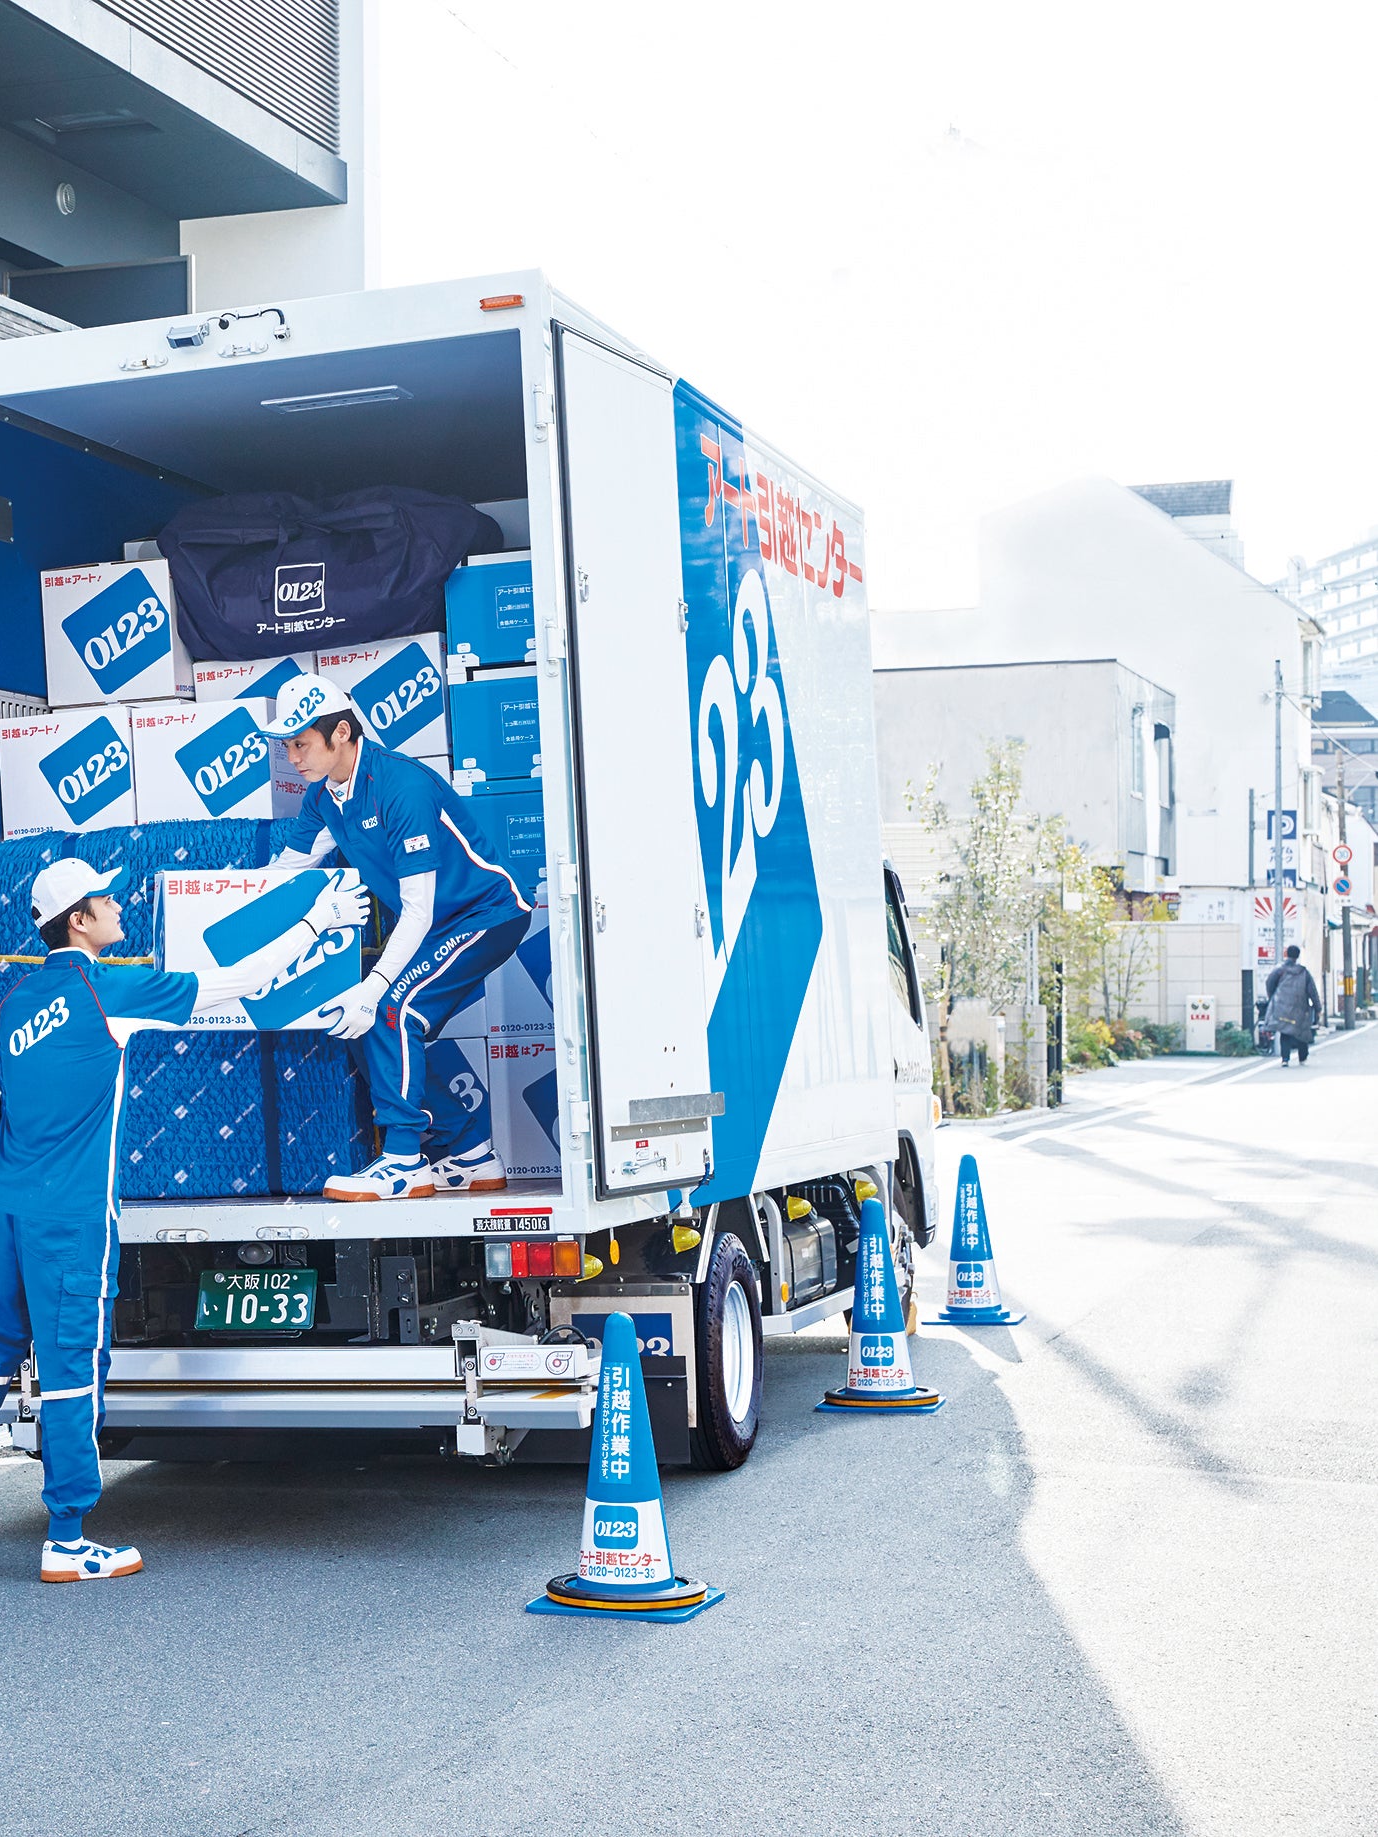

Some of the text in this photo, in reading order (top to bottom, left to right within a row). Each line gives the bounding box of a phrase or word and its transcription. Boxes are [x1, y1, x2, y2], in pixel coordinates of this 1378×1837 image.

[700, 433, 863, 599] アート引越センター
[44, 574, 102, 588] 引越はアート!
[278, 580, 324, 602] 0123
[497, 586, 533, 595] アート引越セ
[84, 597, 165, 670] 0123
[256, 616, 346, 634] アート引越センター
[320, 650, 379, 666] 引越はアート!
[196, 666, 254, 682] 引越はアート!
[370, 666, 440, 730] 0123
[503, 703, 539, 711] アート引越セ
[283, 687, 326, 728] 0123
[136, 714, 196, 728] 引越はアート!
[1, 724, 60, 739] 引越はアート!
[58, 740, 128, 804] 0123
[194, 731, 269, 796] 0123
[698, 568, 784, 967] 23
[362, 816, 378, 829] 0123
[509, 816, 544, 825] アート引越セ
[168, 879, 267, 895] 引越はアート!
[390, 961, 431, 1002] MOVING
[9, 996, 70, 1056] 0123
[189, 1016, 247, 1025] 120-0123-33
[386, 1004, 397, 1030] ART
[491, 1043, 556, 1059] 引越はアー
[869, 1235, 885, 1320] 引越作業中
[958, 1272, 983, 1281] 0123
[203, 1293, 309, 1324] い 10-33
[862, 1346, 893, 1358] 0123
[610, 1366, 630, 1480] 引越作業中
[595, 1520, 637, 1538] 0123
[588, 1565, 655, 1579] 0120-0123-33
